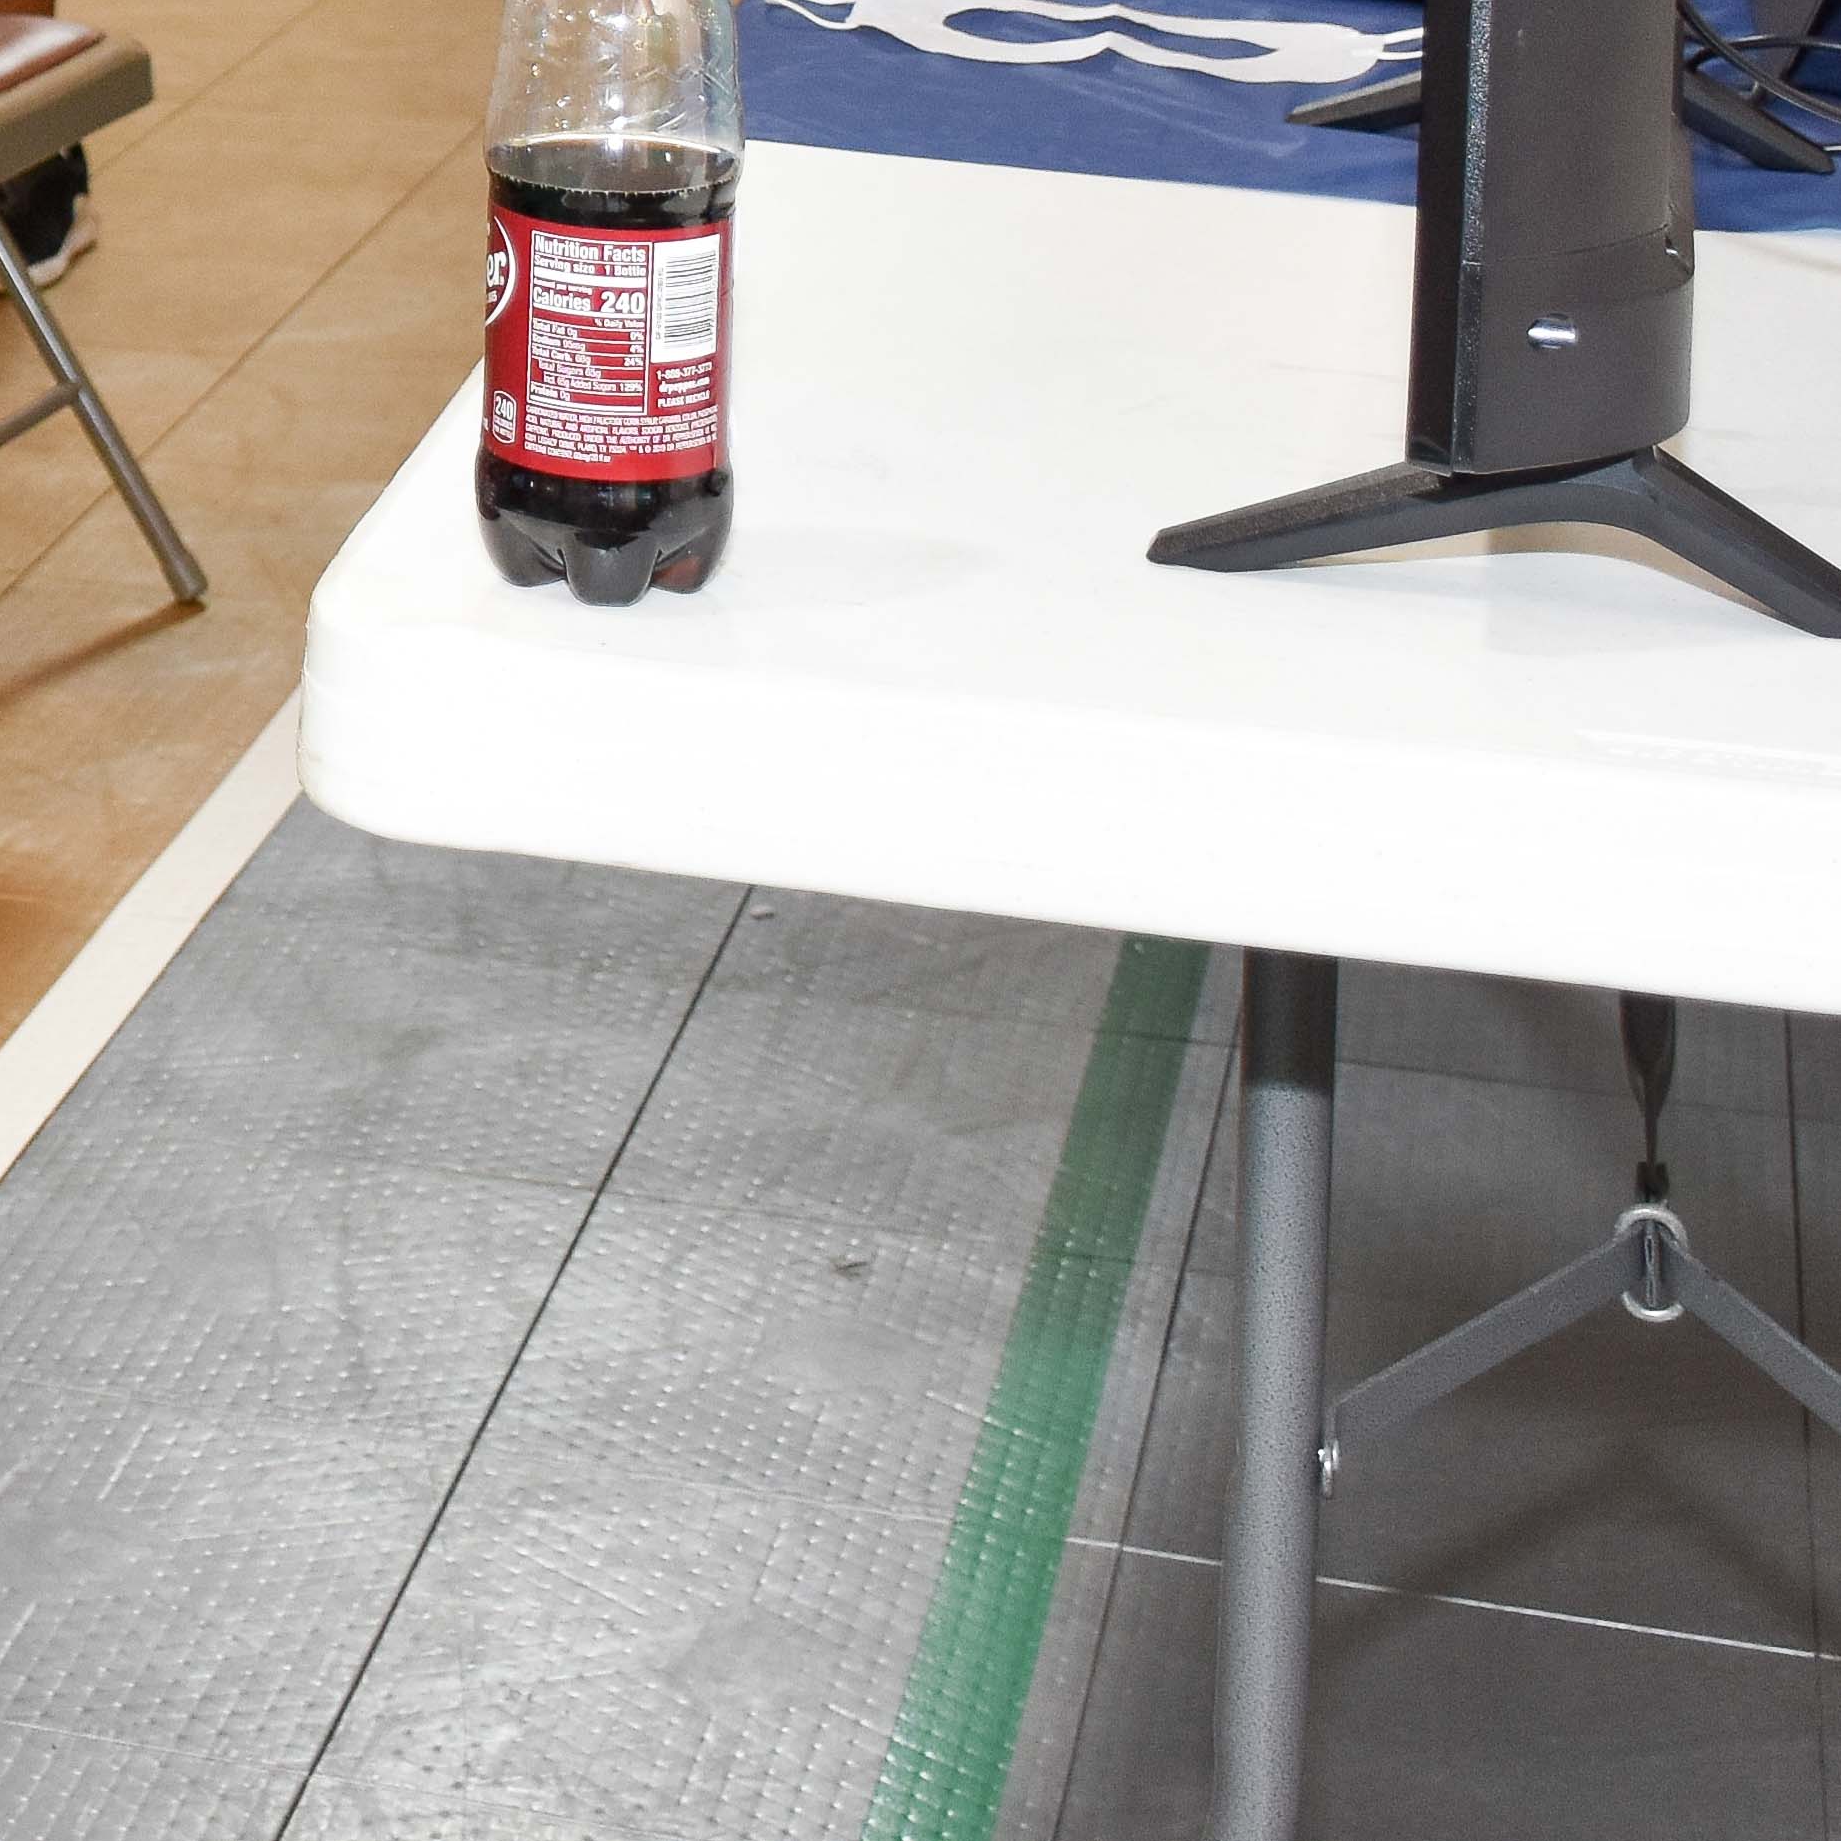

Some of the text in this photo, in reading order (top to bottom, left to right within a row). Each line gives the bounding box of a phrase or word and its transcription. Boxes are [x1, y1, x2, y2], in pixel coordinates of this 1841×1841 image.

[534, 234, 646, 262] Nutrition Facts
[534, 255, 646, 277] Serving size 1 Bottle
[533, 286, 646, 314] Calories 240
[630, 331, 644, 341] 0%
[623, 357, 644, 367] 24%
[495, 395, 514, 421] 240
